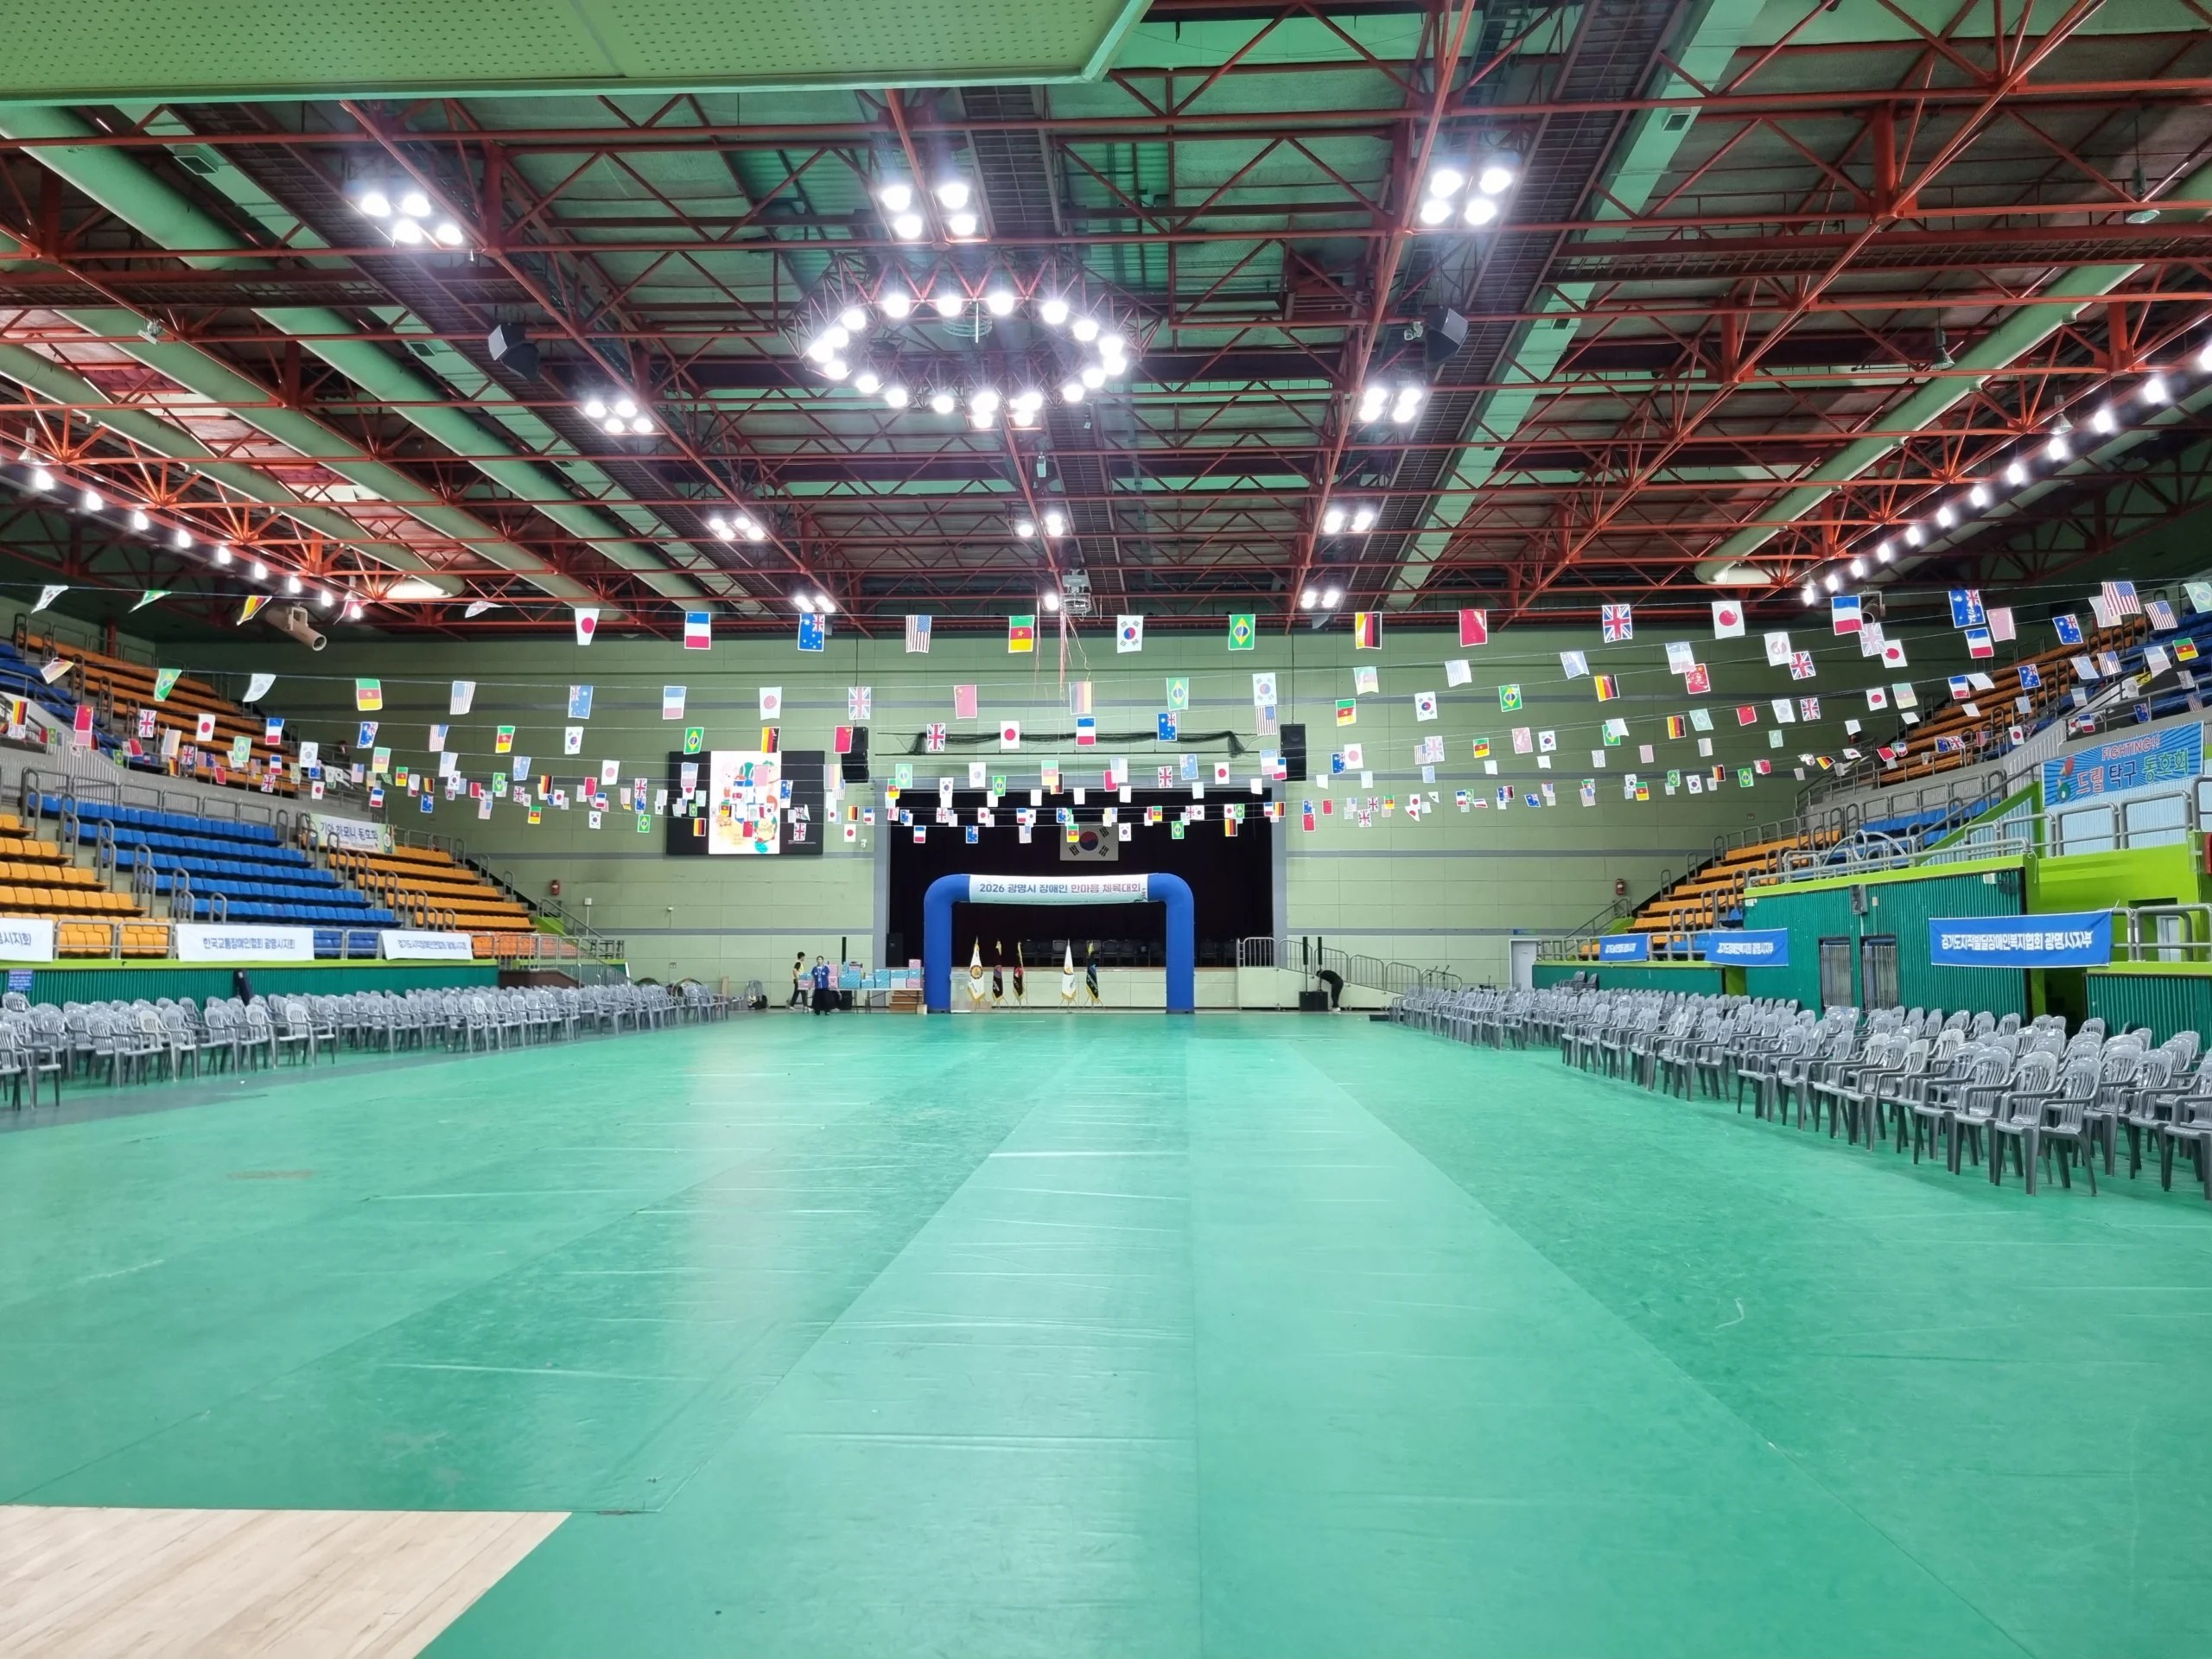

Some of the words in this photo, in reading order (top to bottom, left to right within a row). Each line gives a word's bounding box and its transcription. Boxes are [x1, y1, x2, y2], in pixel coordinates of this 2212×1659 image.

[2075, 766, 2105, 794] 드림
[2108, 760, 2137, 788] 탁구
[2143, 748, 2189, 782] 동호회
[359, 828, 378, 841] 동호회
[980, 883, 1005, 893] 2026
[1007, 884, 1037, 893] 광명시
[1039, 884, 1068, 893] 장애인
[1071, 884, 1100, 893] 한마음
[1102, 883, 1141, 893] 체육대회
[2044, 931, 2093, 950] 광명시지부
